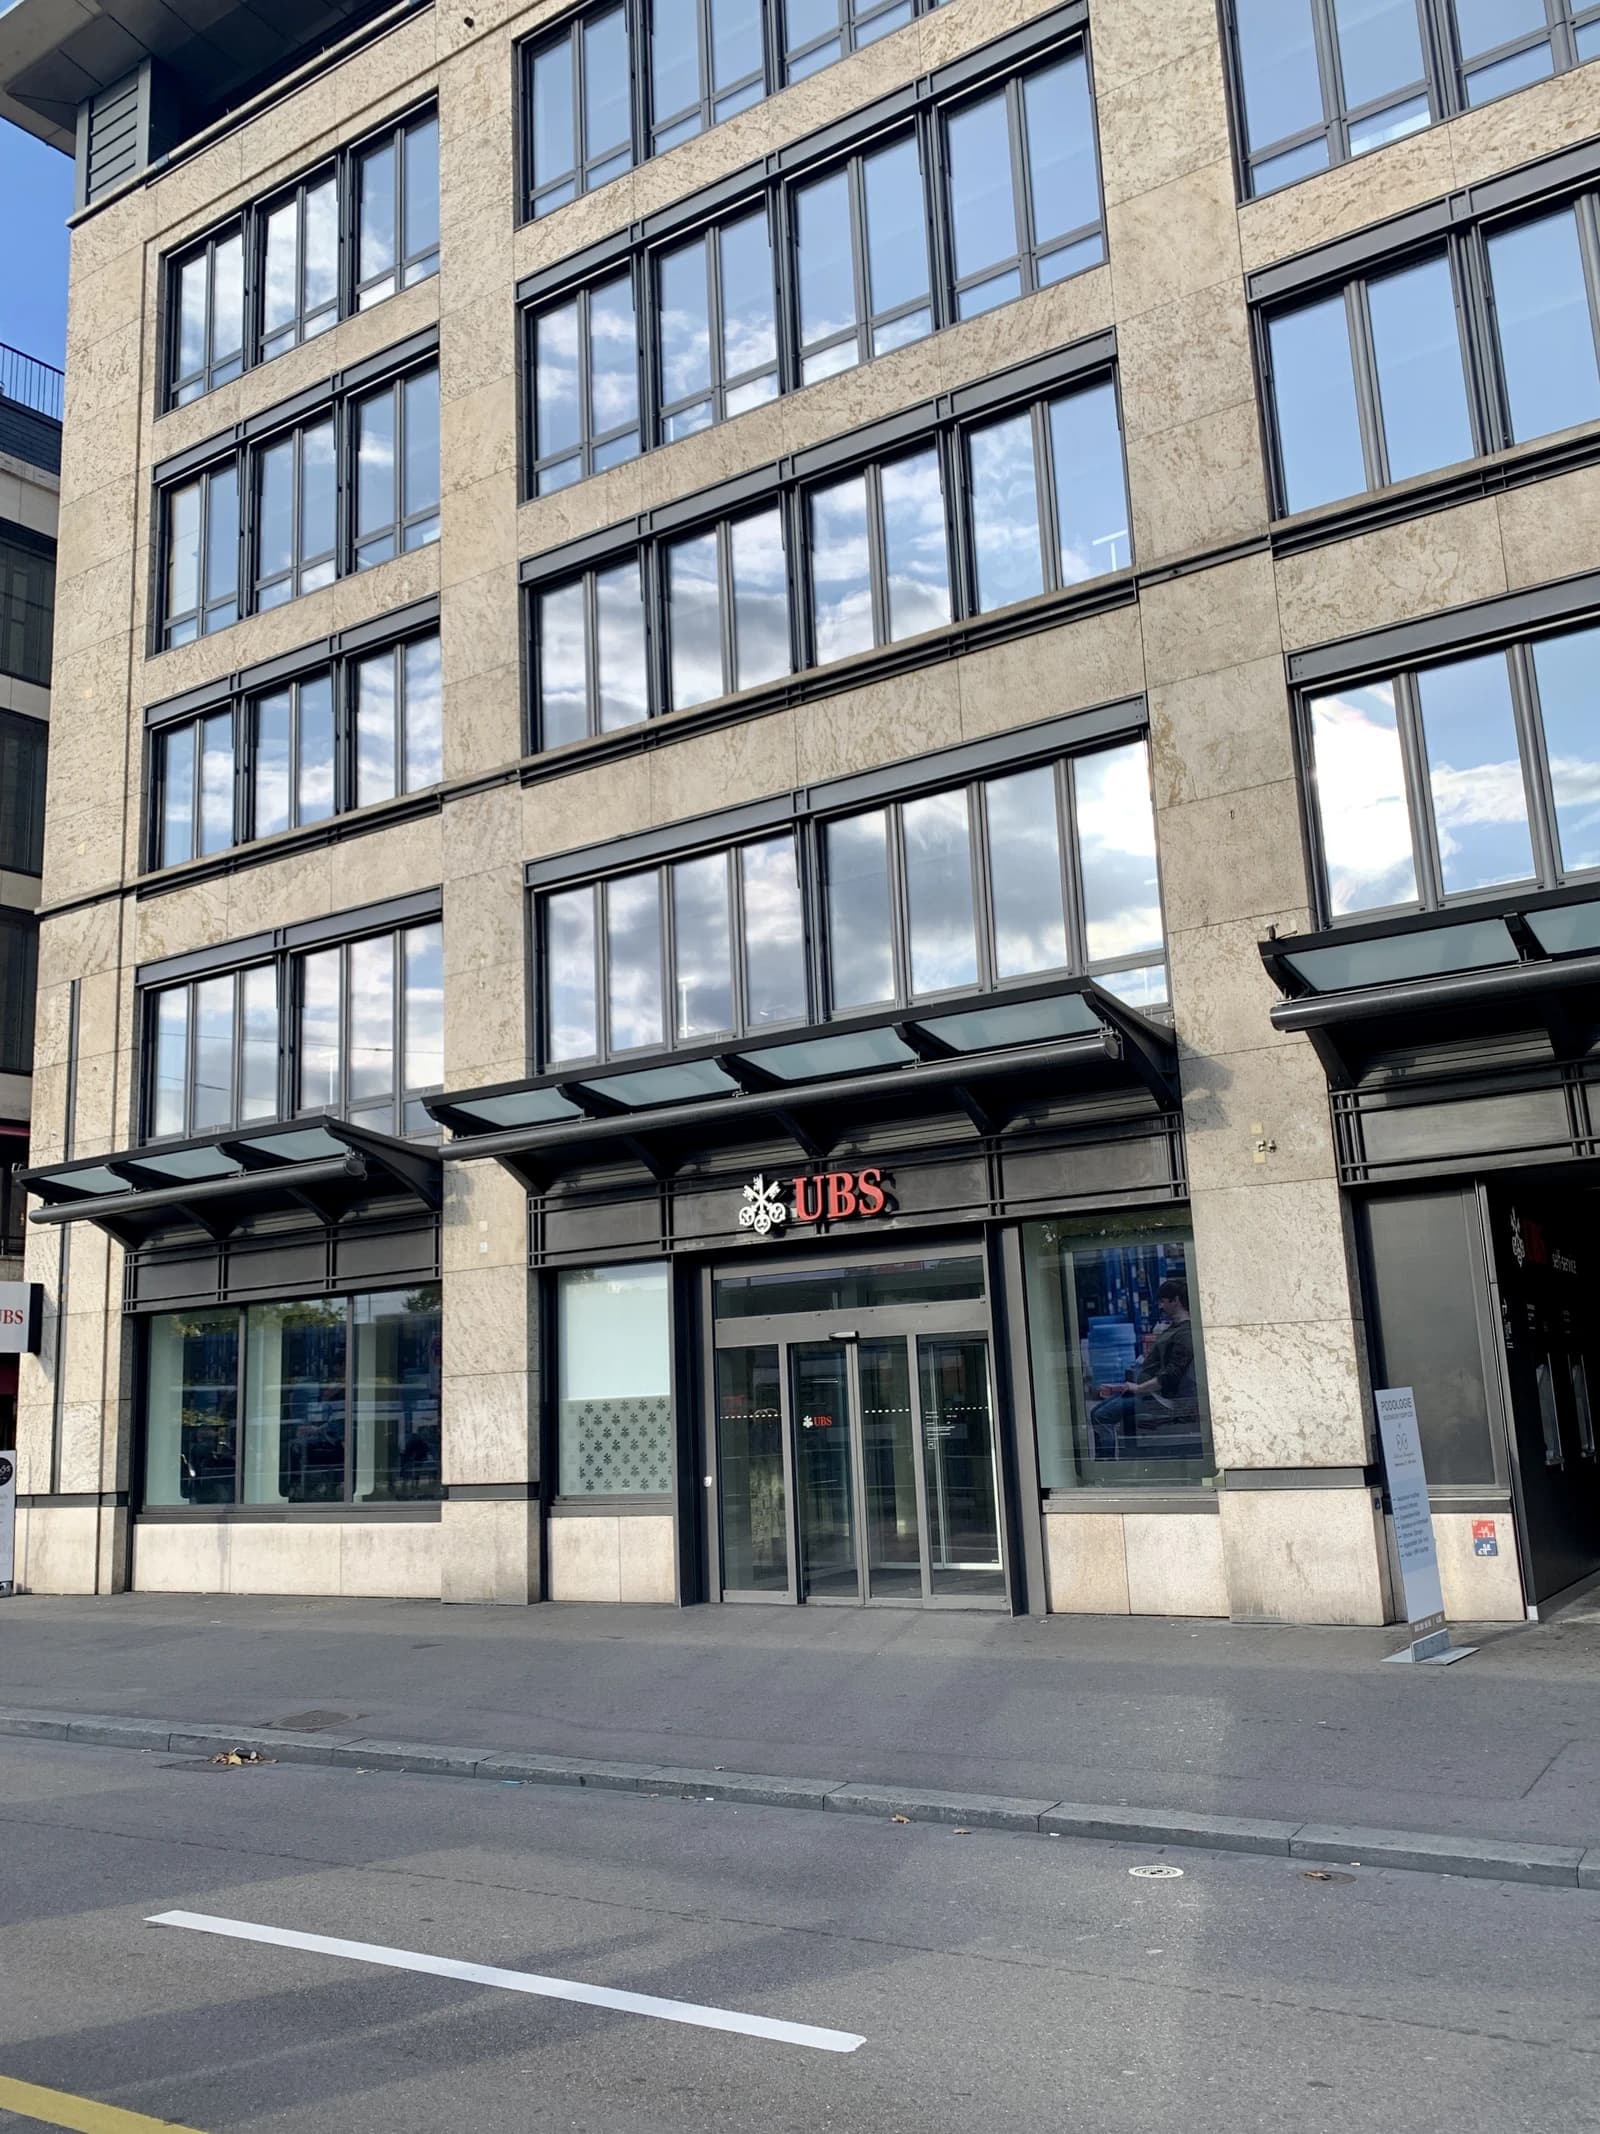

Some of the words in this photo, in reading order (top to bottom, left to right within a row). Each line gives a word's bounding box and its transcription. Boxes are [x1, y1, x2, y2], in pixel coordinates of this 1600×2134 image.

[792, 1168, 886, 1222] UBS
[0, 1309, 24, 1325] BS
[1380, 1397, 1413, 1412] PODOLOGIE
[813, 1416, 832, 1427] UBS
